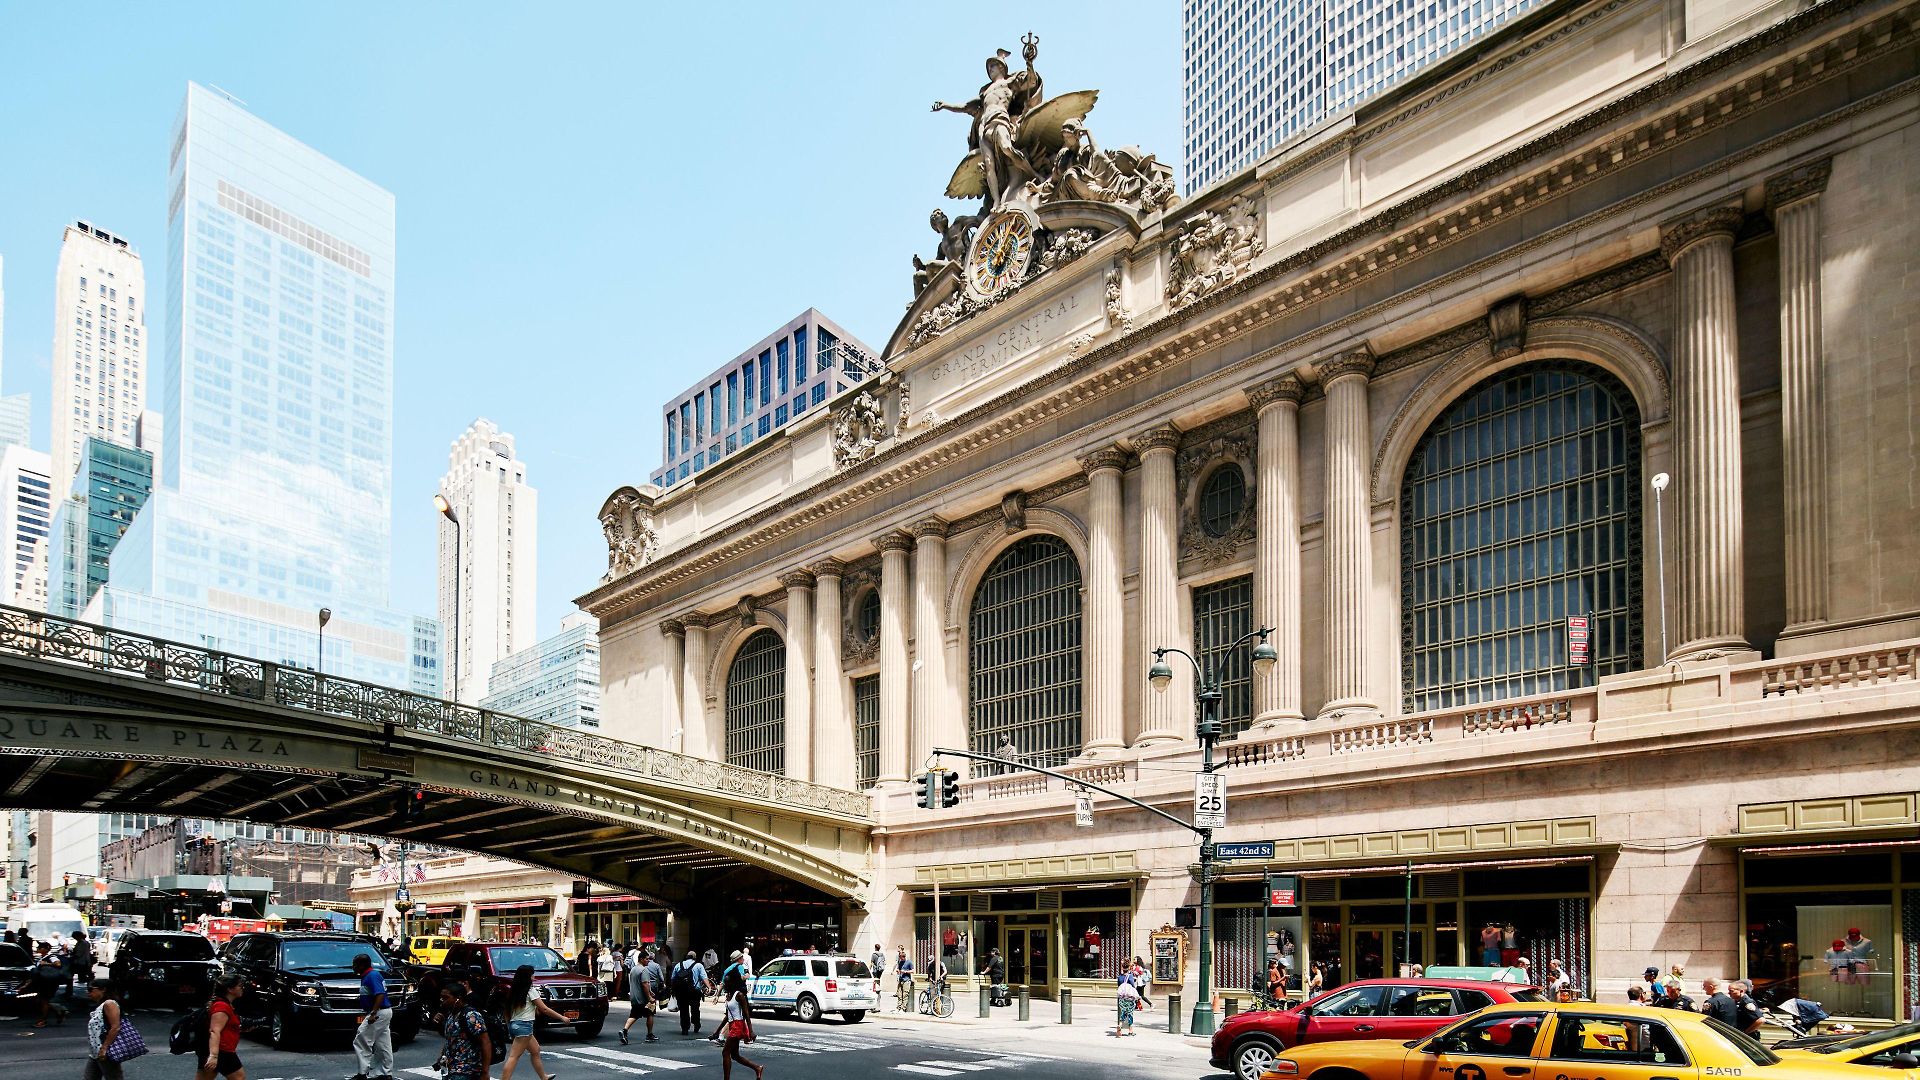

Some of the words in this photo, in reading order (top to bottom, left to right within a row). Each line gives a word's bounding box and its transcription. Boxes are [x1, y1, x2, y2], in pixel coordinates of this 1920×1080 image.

[931, 344, 985, 381] GRAND
[997, 296, 1079, 346] CENTRAL
[961, 330, 1045, 380] TERMINAL
[172, 730, 289, 756] PLAZA
[1081, 803, 1089, 811] NO
[1199, 796, 1221, 811] 25
[470, 770, 557, 797] GRAND
[574, 791, 668, 824] CENTRAL
[682, 817, 769, 856] TERMINAL
[1078, 813, 1093, 821] TURNS
[1220, 847, 1237, 855] East
[752, 984, 777, 995] NYPD
